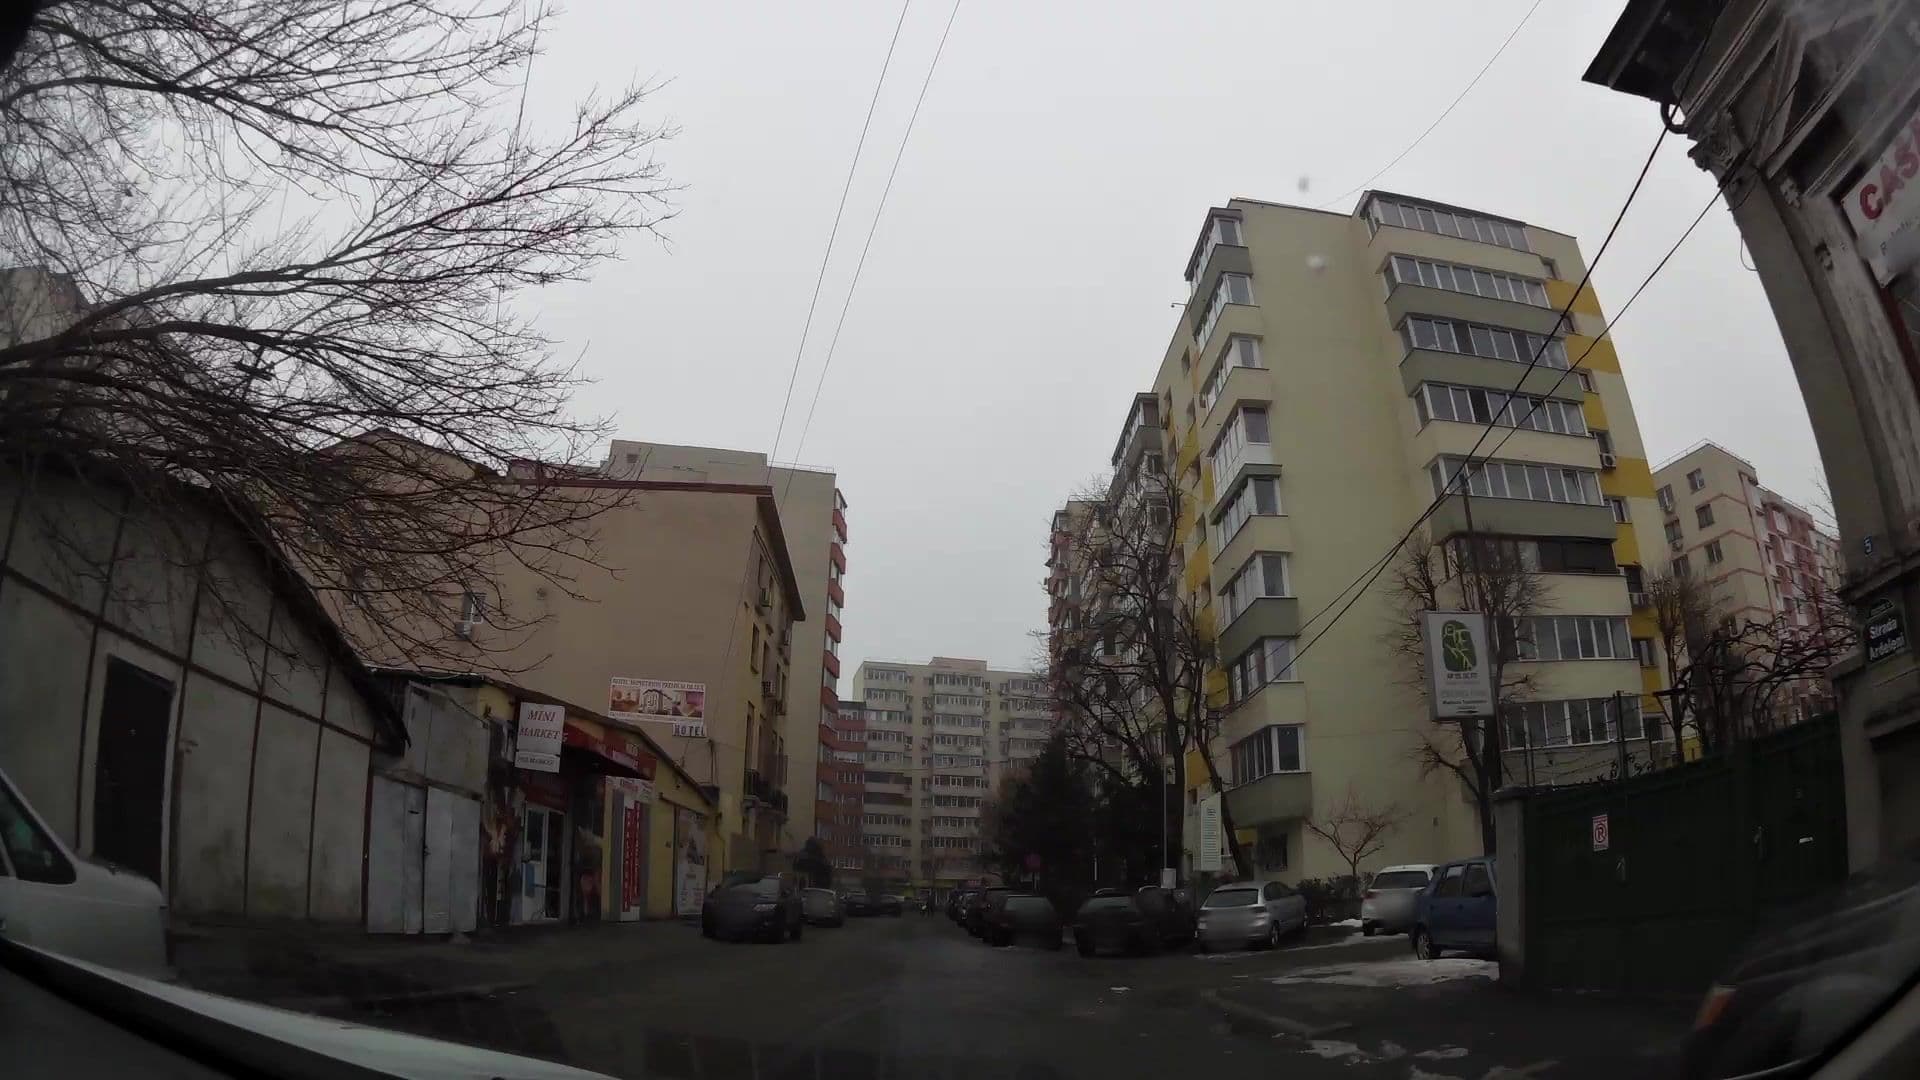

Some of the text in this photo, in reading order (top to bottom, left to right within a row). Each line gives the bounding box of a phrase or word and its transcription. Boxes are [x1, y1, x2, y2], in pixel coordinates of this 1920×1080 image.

[1869, 618, 1897, 640] Strada
[528, 710, 556, 721] MINI
[520, 728, 561, 739] MARKET
[674, 725, 705, 736] HOTEL
